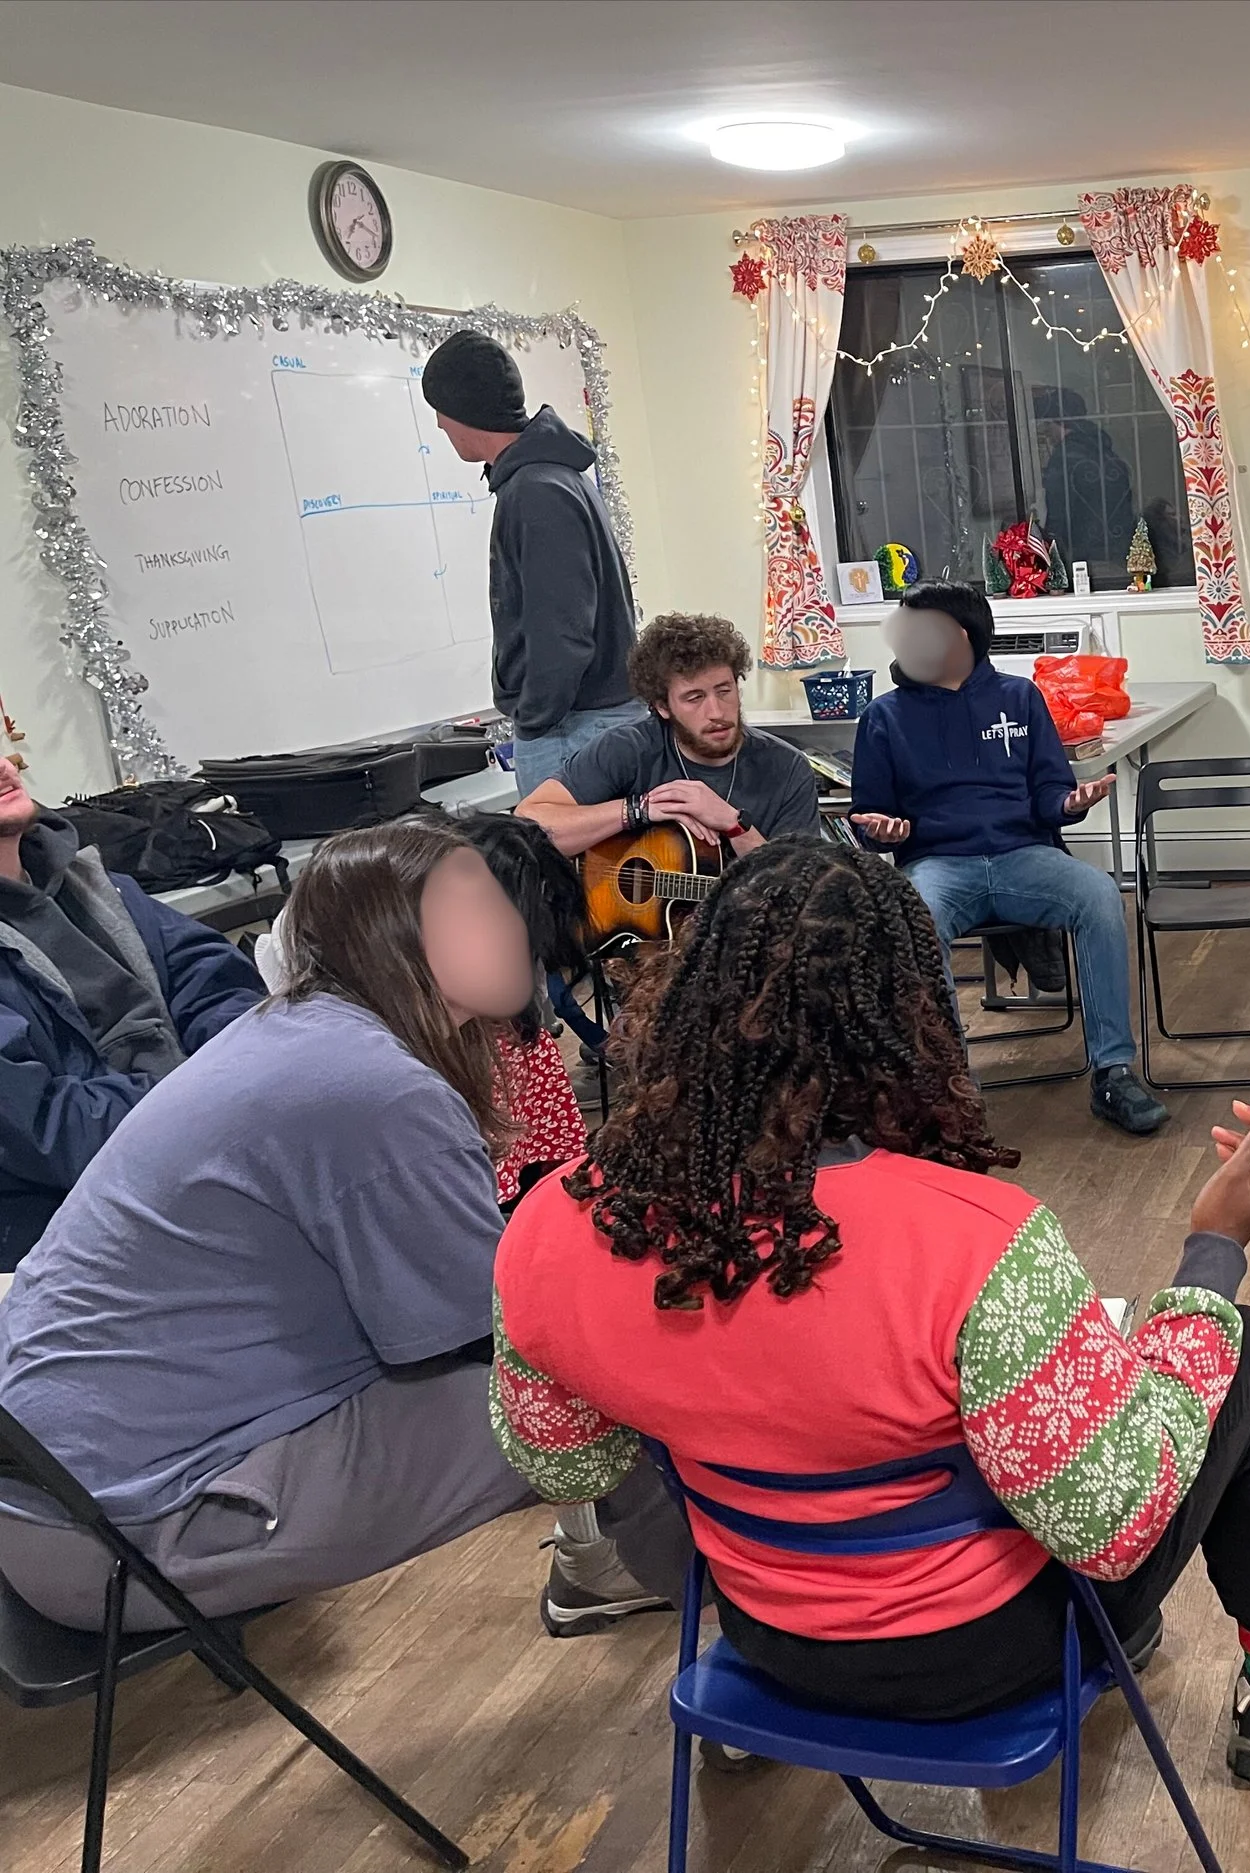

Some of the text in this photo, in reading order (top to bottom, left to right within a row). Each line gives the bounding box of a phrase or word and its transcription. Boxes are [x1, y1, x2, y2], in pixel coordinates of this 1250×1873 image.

[347, 181, 357, 196] 12
[367, 202, 374, 215] 2
[355, 248, 361, 260] 6
[272, 355, 306, 369] CASUAL
[104, 401, 211, 432] ADORATION
[119, 469, 223, 505] CONFESSION
[303, 493, 342, 511] DISCOVERY
[432, 490, 463, 501] SPIRITUAL
[134, 544, 231, 573] THANKSGIVING
[149, 600, 235, 640] SUPPLICATION
[1009, 725, 1028, 738] PRAY
